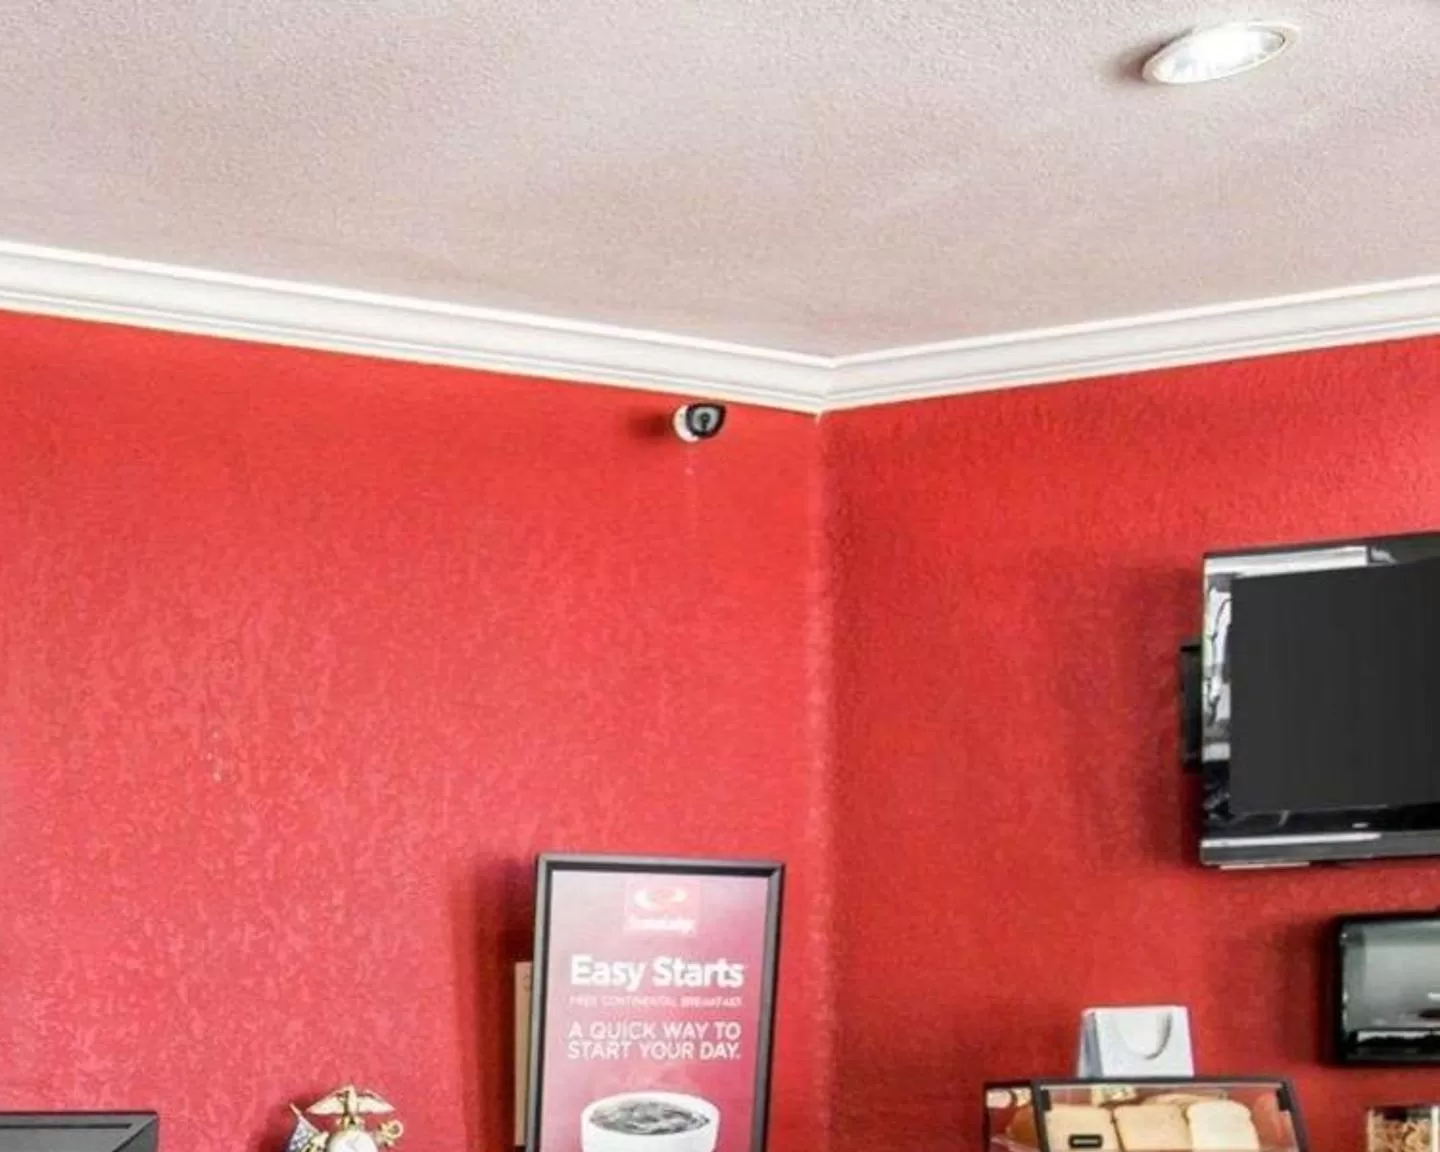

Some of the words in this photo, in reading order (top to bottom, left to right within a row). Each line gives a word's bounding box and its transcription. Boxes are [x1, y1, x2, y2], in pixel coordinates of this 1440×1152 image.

[570, 954, 645, 992] Easy
[652, 956, 745, 988] Starts
[568, 1021, 583, 1039] A
[589, 1021, 657, 1041] QUICK
[662, 1021, 710, 1040] WAY
[713, 1021, 742, 1040] TO
[567, 1040, 631, 1060] START
[639, 1041, 694, 1060] YOUR
[699, 1041, 742, 1060] DAY.
